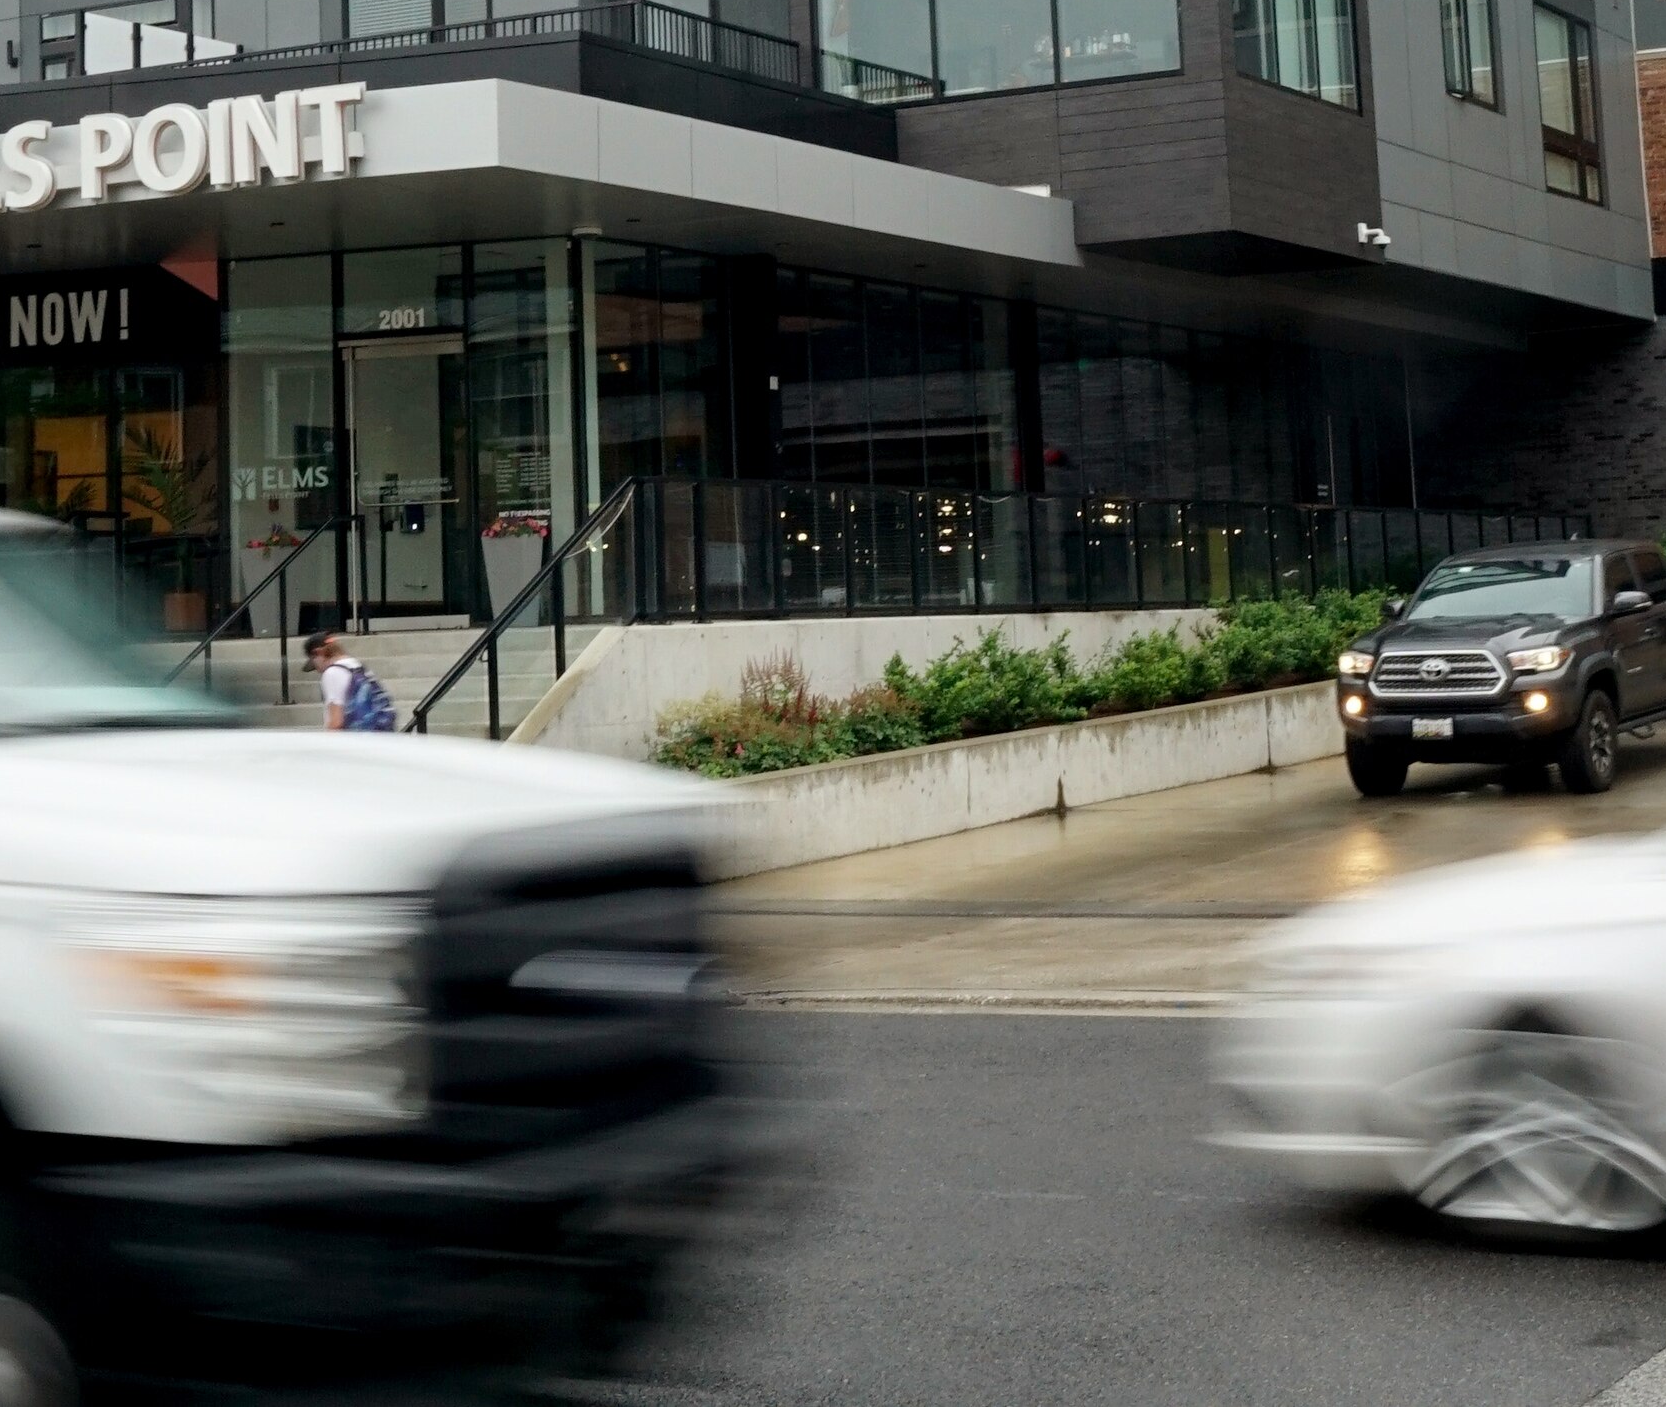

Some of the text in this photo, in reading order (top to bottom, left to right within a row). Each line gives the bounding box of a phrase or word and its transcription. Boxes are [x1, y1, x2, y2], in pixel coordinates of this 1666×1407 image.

[80, 81, 365, 200] POINT
[379, 307, 425, 330] 2001
[262, 466, 329, 490] ELMS
